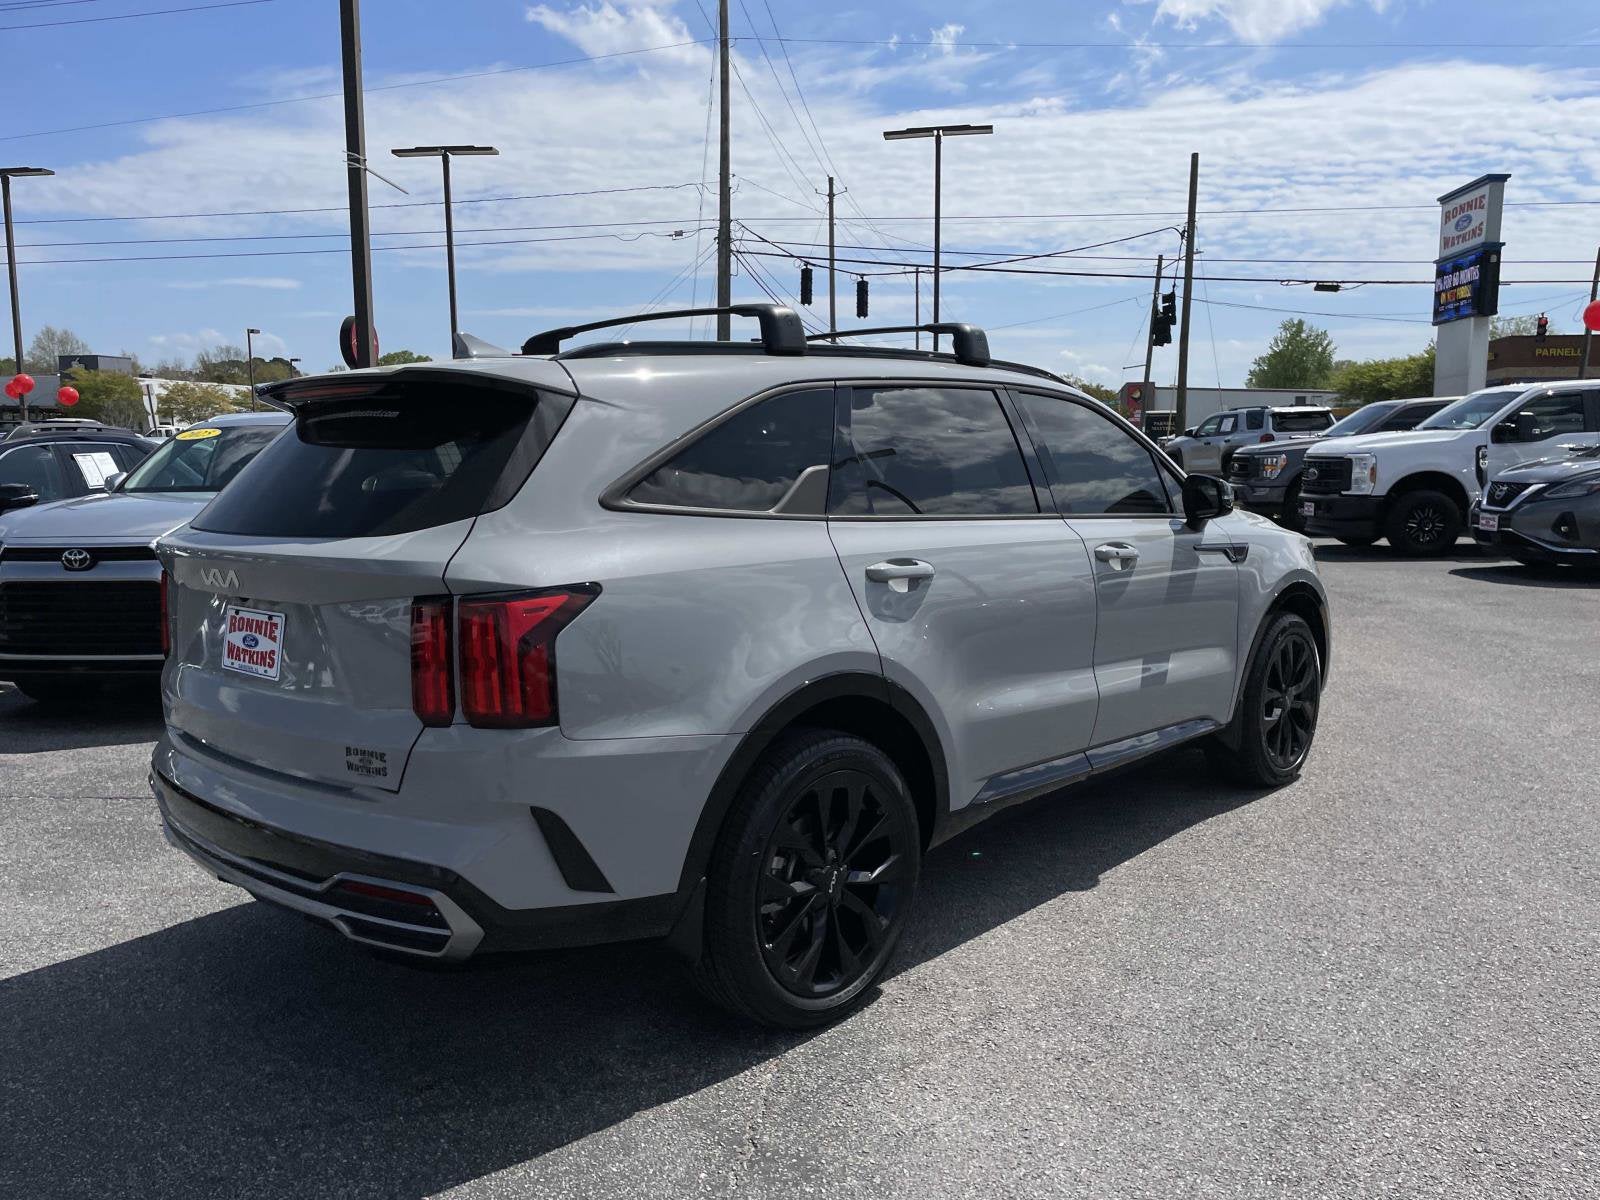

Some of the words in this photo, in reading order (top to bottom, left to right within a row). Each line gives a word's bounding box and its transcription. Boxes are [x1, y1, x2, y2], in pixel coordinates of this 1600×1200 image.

[1444, 194, 1486, 225] RONNIE
[1443, 221, 1484, 250] WATKINS
[1535, 348, 1582, 356] PARNELL
[201, 568, 239, 589] KIA
[228, 614, 279, 643] RONNIE
[227, 640, 276, 669] WATKINS
[345, 746, 386, 762] RONNIE
[346, 760, 388, 777] WATKINS
